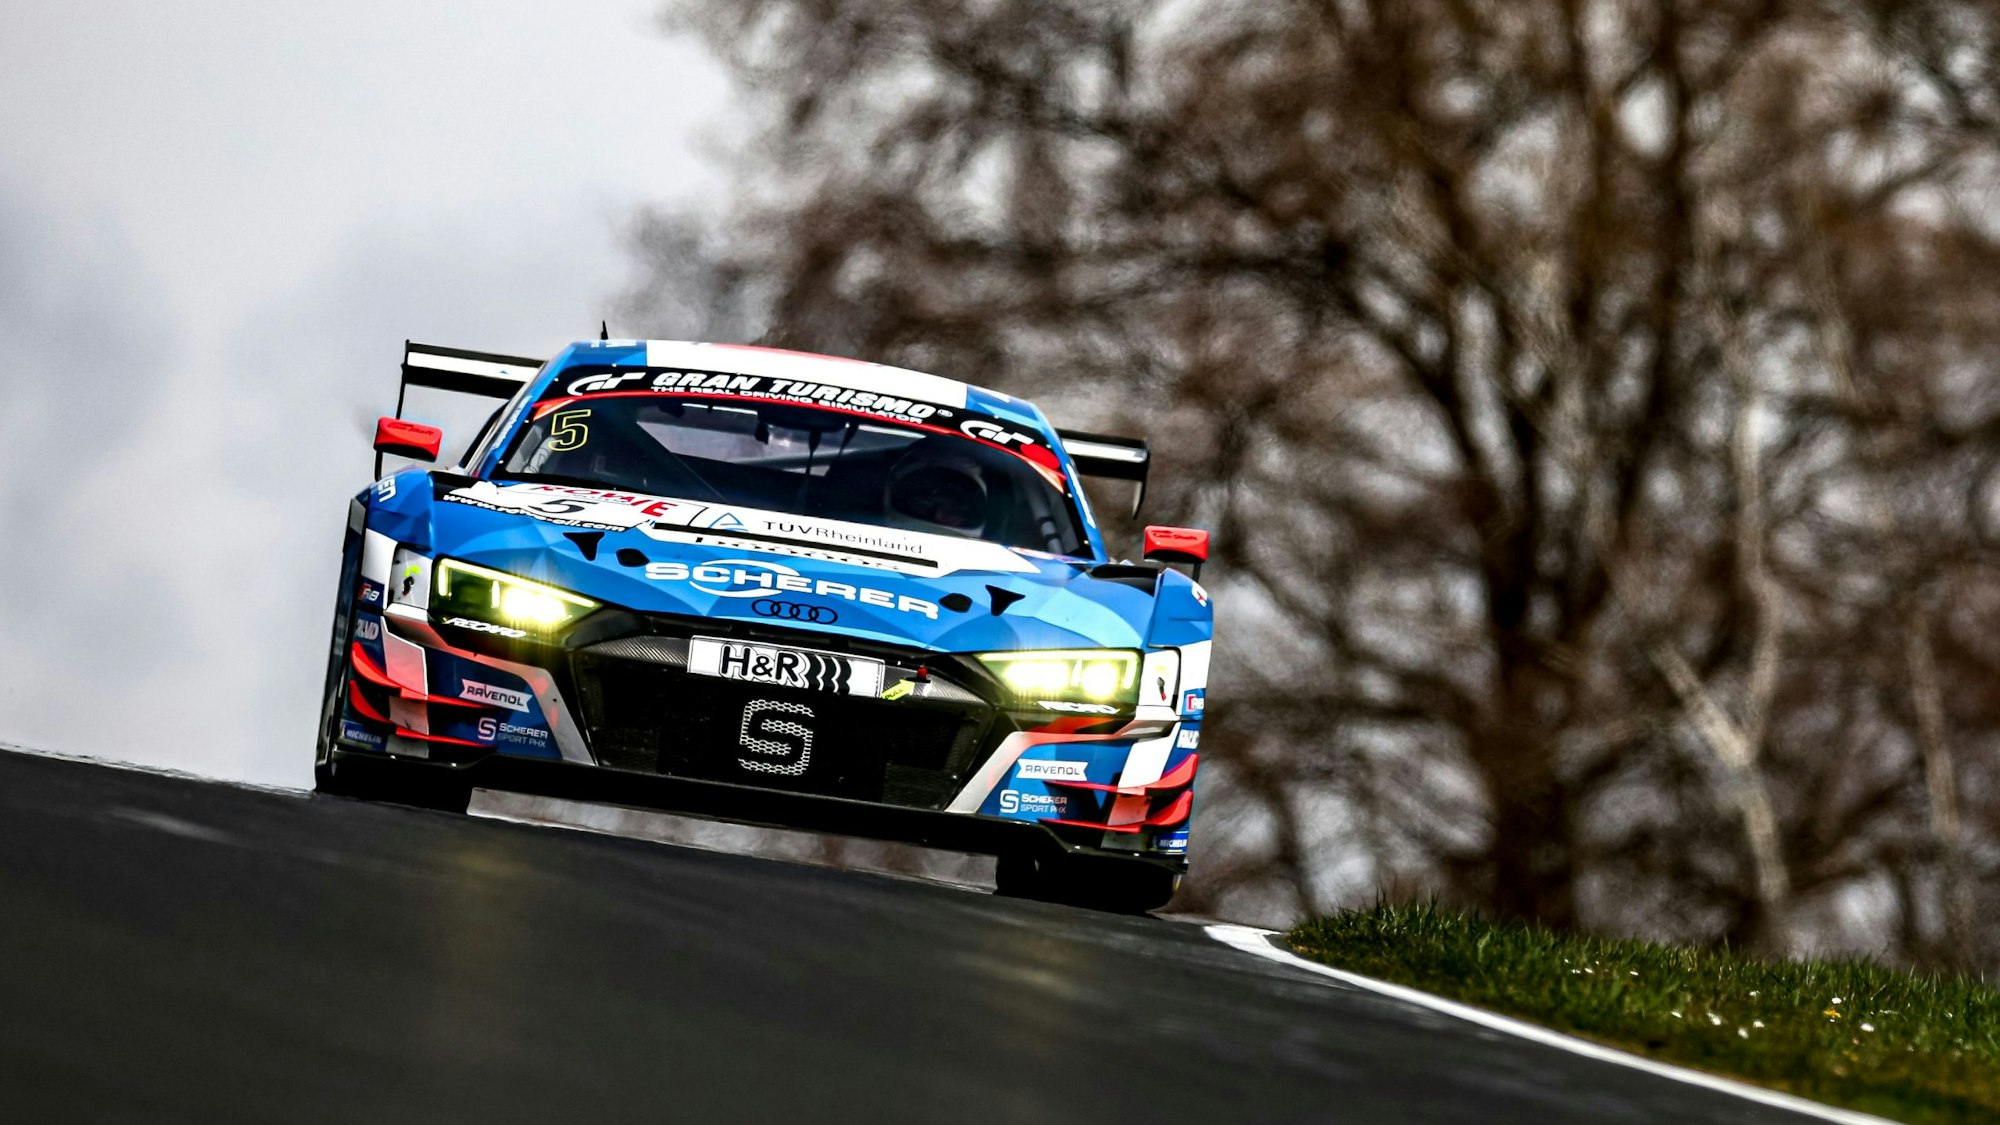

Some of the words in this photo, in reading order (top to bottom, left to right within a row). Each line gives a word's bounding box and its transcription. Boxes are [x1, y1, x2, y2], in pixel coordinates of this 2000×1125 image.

[652, 372, 761, 390] GRAN
[690, 387, 735, 396] REAL
[740, 390, 813, 404] DRIVING
[818, 399, 923, 425] SIMULATOR
[548, 409, 591, 451] 5
[528, 498, 599, 514] 5
[645, 561, 939, 620] SCHERER
[720, 643, 801, 684] H&R
[466, 685, 524, 707] RAVENOL
[499, 722, 548, 739] SCHERER
[738, 699, 815, 776] S
[498, 733, 526, 744] SPORT
[529, 736, 547, 748] PHX
[1025, 764, 1080, 776] RAVENOL
[1021, 793, 1068, 805] SCHERER
[1020, 804, 1049, 813] SPORT
